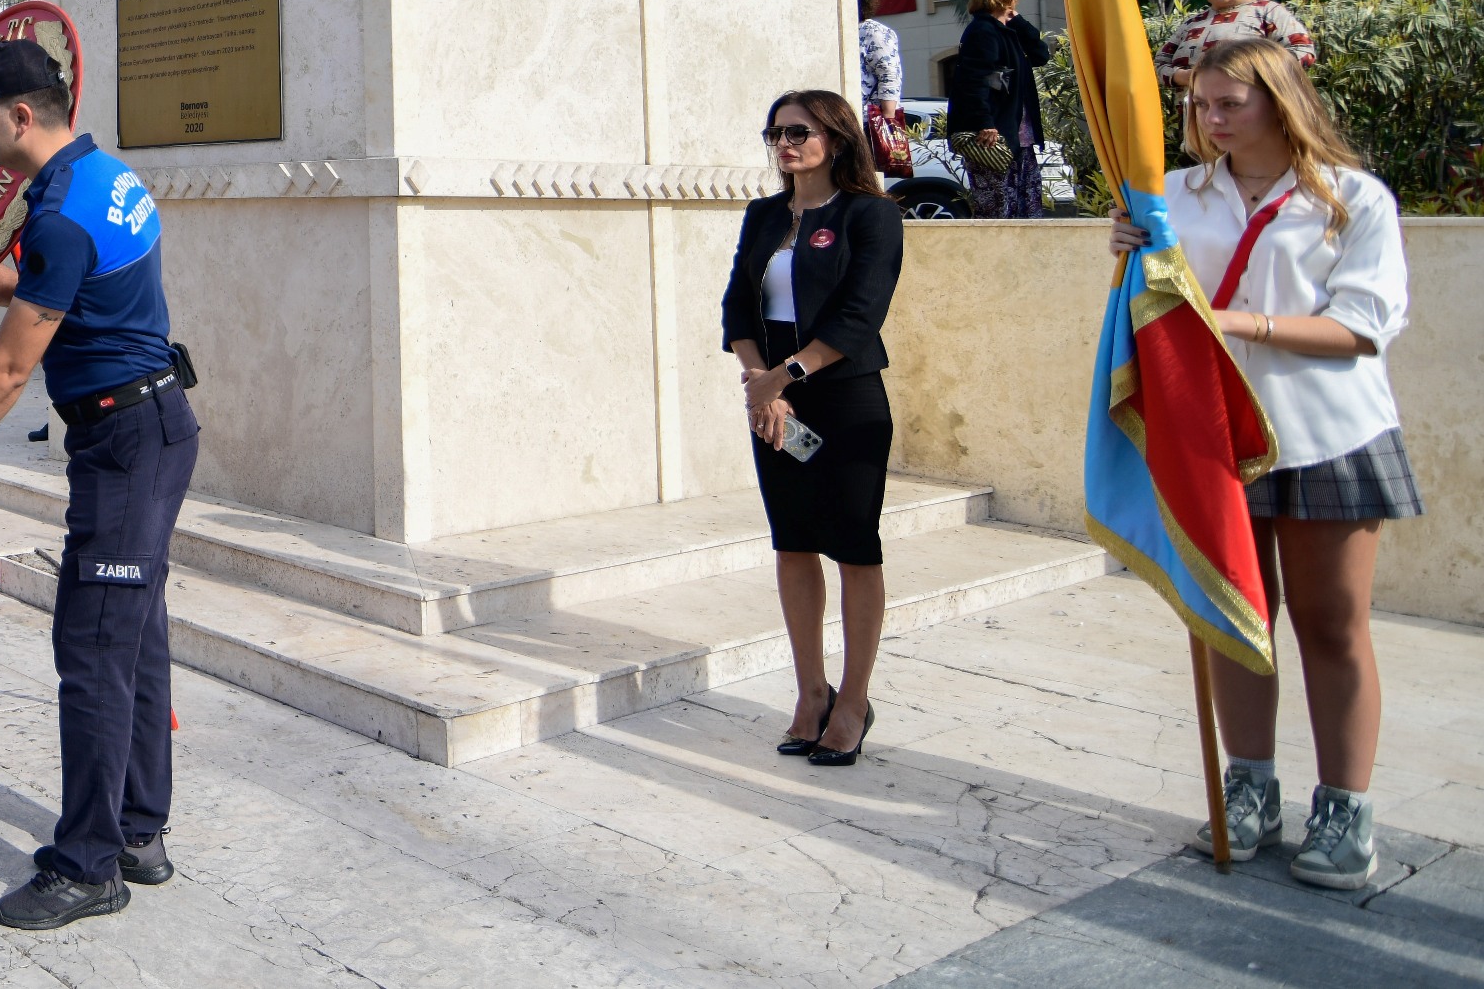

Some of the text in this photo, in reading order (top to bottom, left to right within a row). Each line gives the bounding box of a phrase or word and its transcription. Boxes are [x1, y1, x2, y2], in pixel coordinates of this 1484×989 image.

[180, 101, 208, 111] Bornova
[185, 122, 204, 133] 2020
[106, 171, 144, 226] BORNOV
[124, 193, 156, 236] ZABITA
[139, 373, 175, 395] ZBITA
[95, 563, 141, 579] ZABITA
